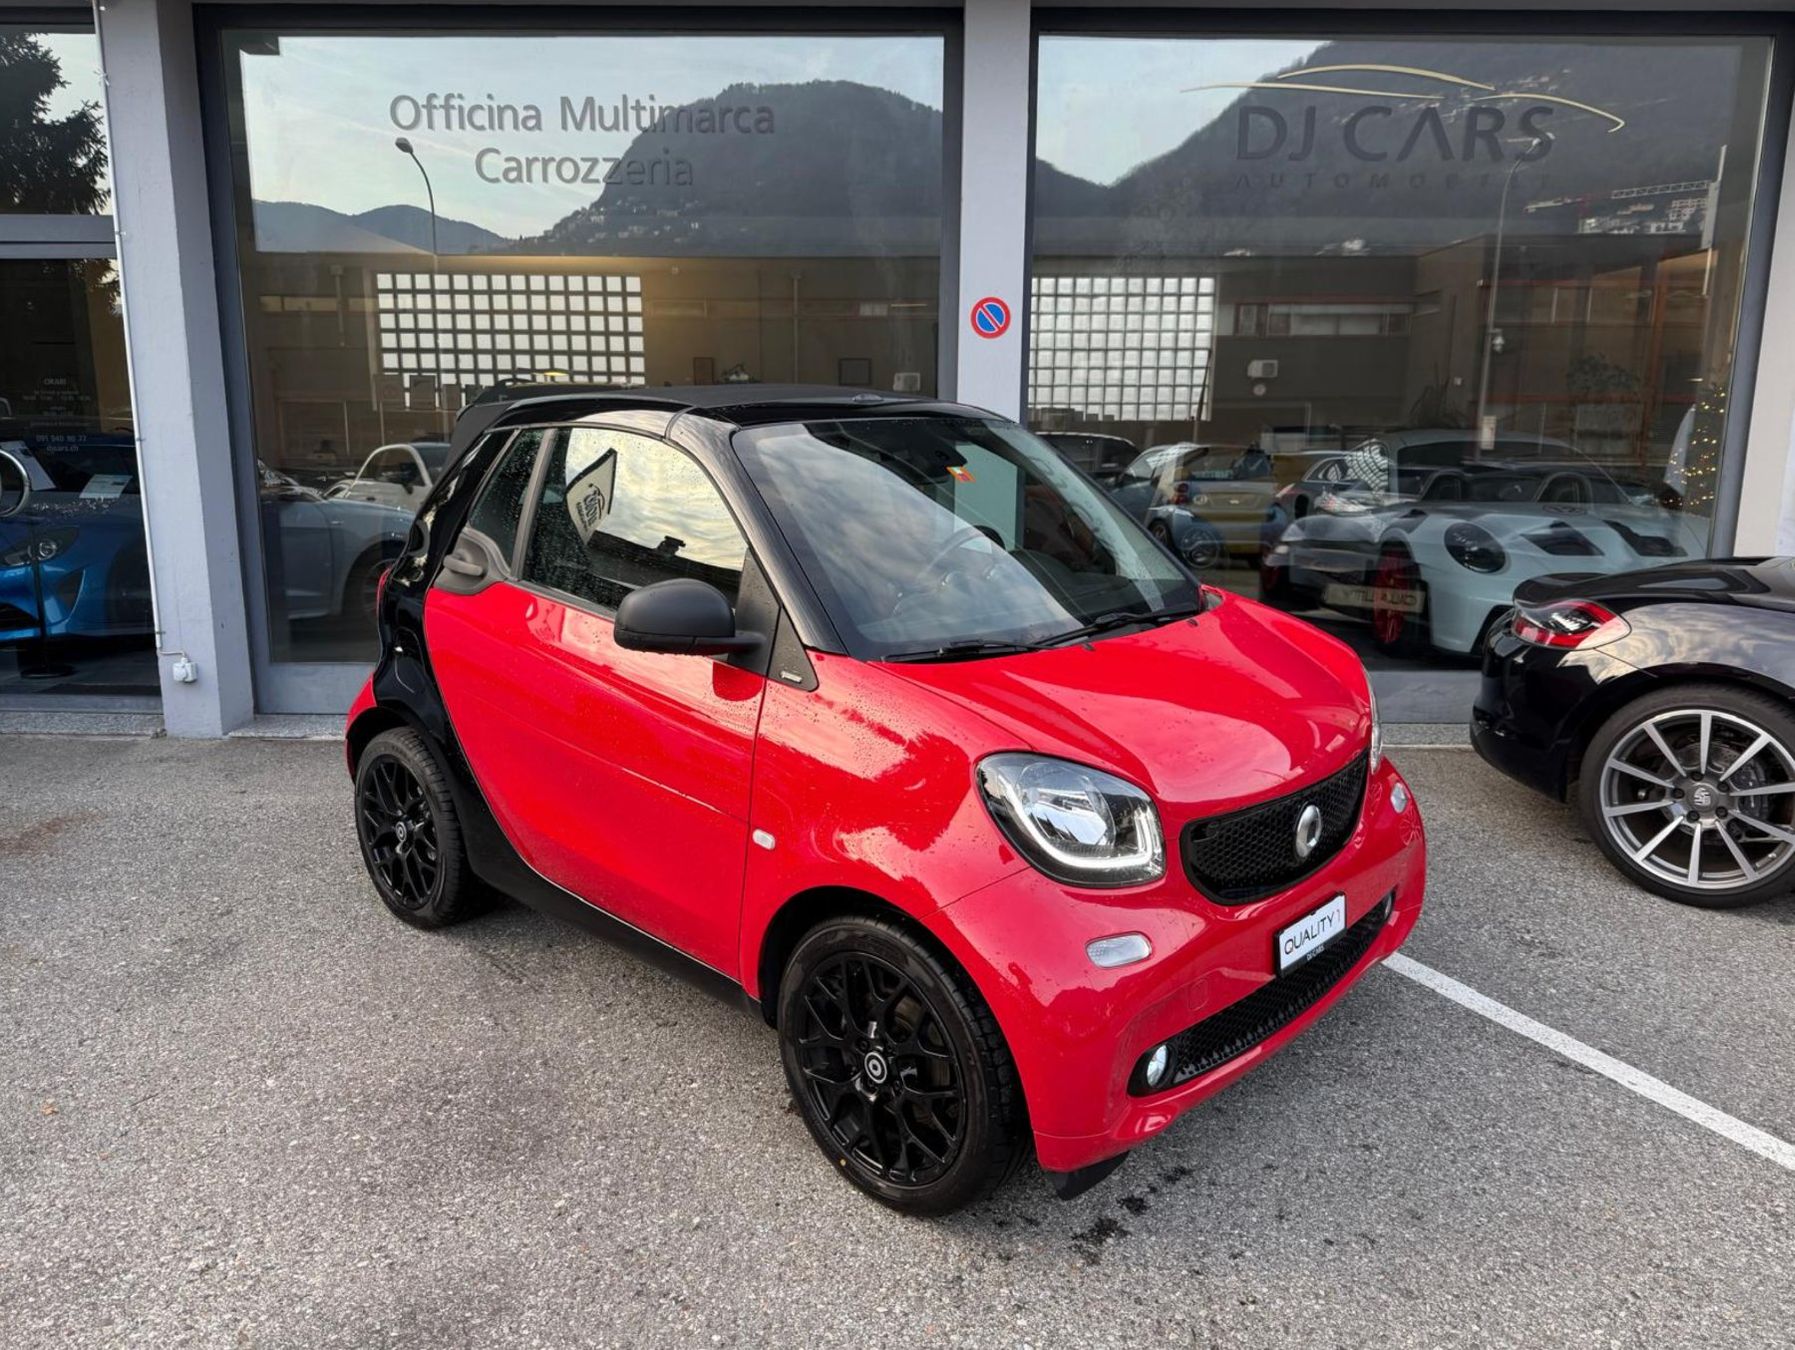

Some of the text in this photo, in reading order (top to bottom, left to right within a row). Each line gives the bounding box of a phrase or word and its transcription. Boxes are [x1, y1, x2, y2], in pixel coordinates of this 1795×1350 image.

[390, 92, 775, 135] Officina Multimarca
[1236, 105, 1555, 162] DJ CARS
[475, 147, 694, 186] Carrozzeria
[1284, 911, 1335, 955] QUALITY
